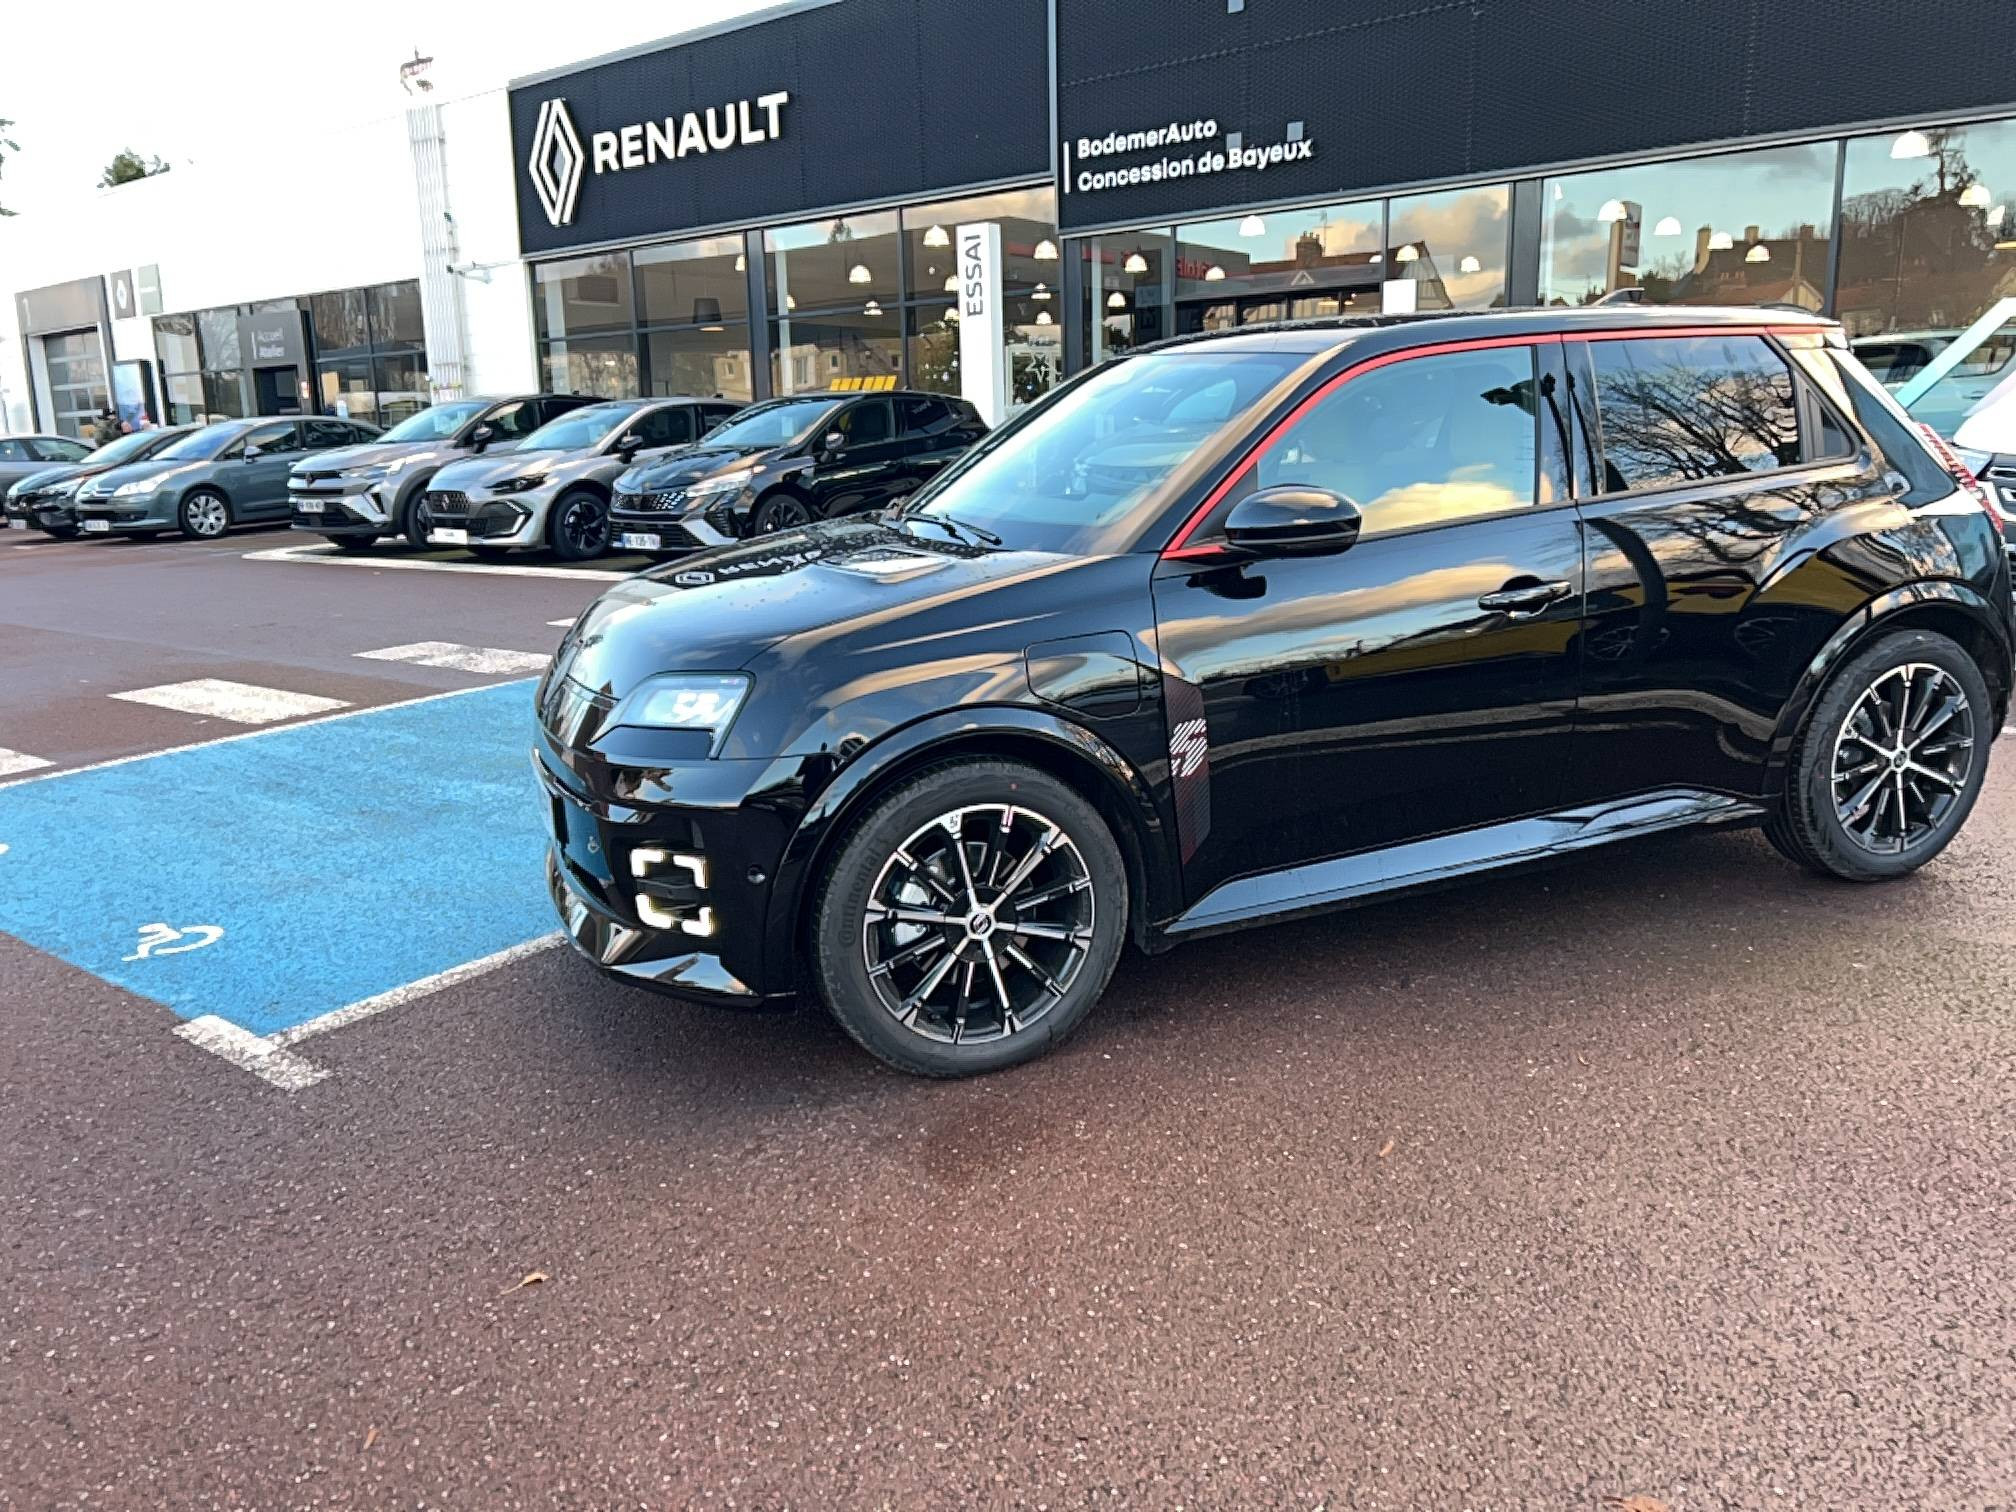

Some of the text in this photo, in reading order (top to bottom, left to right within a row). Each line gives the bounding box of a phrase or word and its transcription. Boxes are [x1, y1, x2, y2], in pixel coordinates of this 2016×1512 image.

[592, 91, 789, 174] RENAULT
[1077, 119, 1218, 159] BodemerAuto
[1077, 138, 1313, 191] Concession de Bayeux
[964, 234, 983, 317] ESSAI
